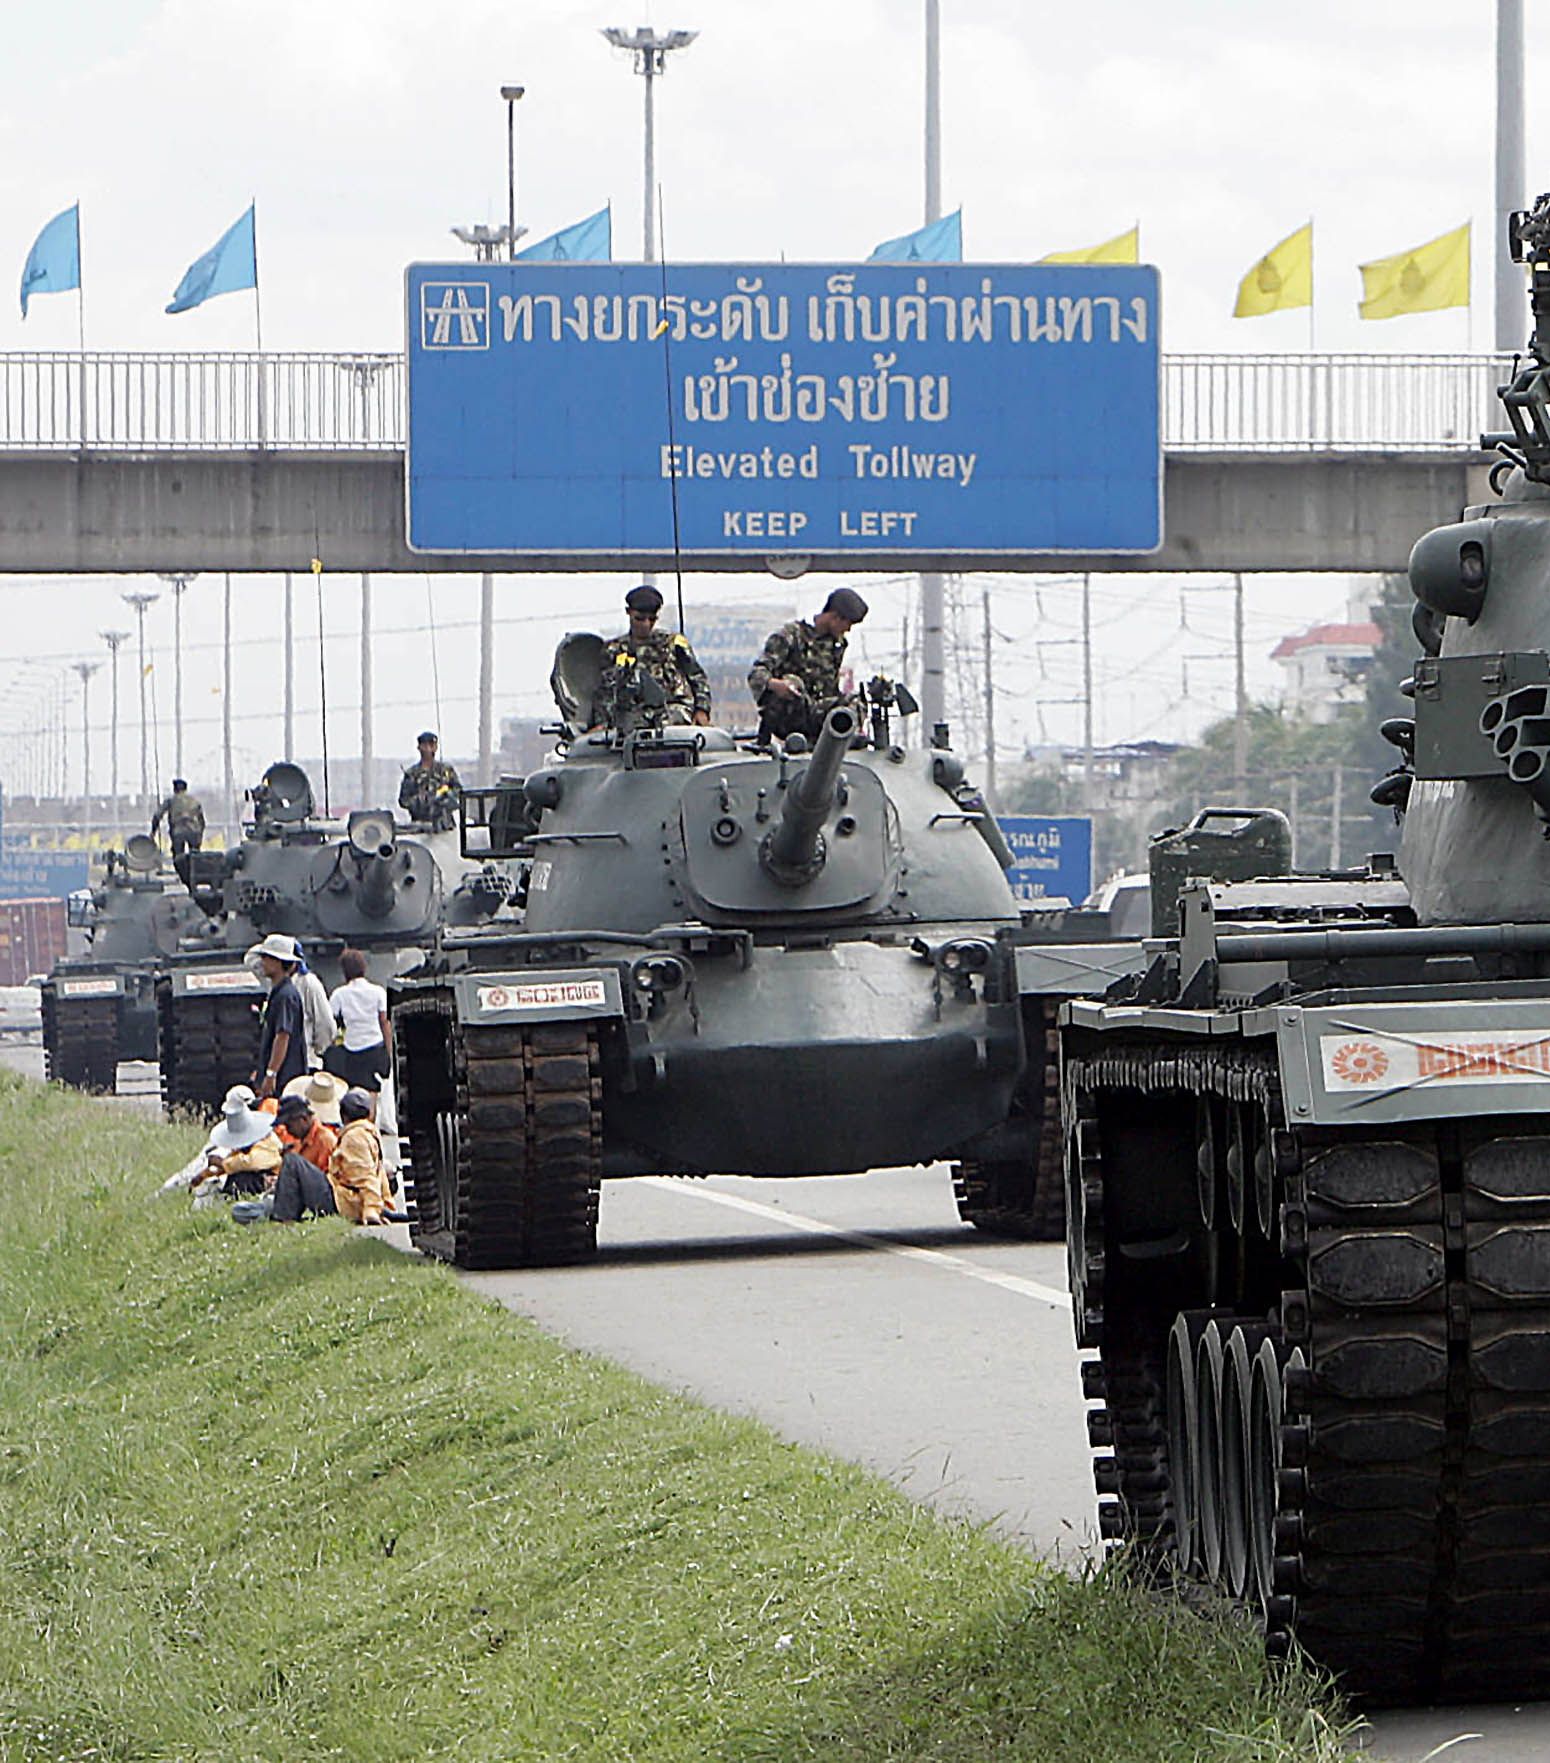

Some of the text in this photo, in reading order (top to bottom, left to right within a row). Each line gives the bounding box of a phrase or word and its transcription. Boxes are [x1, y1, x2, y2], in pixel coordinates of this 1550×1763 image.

[498, 273, 1147, 343] ทางยกระดับ เก็บค่าผ่านทาง
[684, 352, 950, 423] เข้าช่องซ้าย
[660, 445, 976, 487] Elevated Tollway
[723, 511, 918, 536] KEEP LEFT
